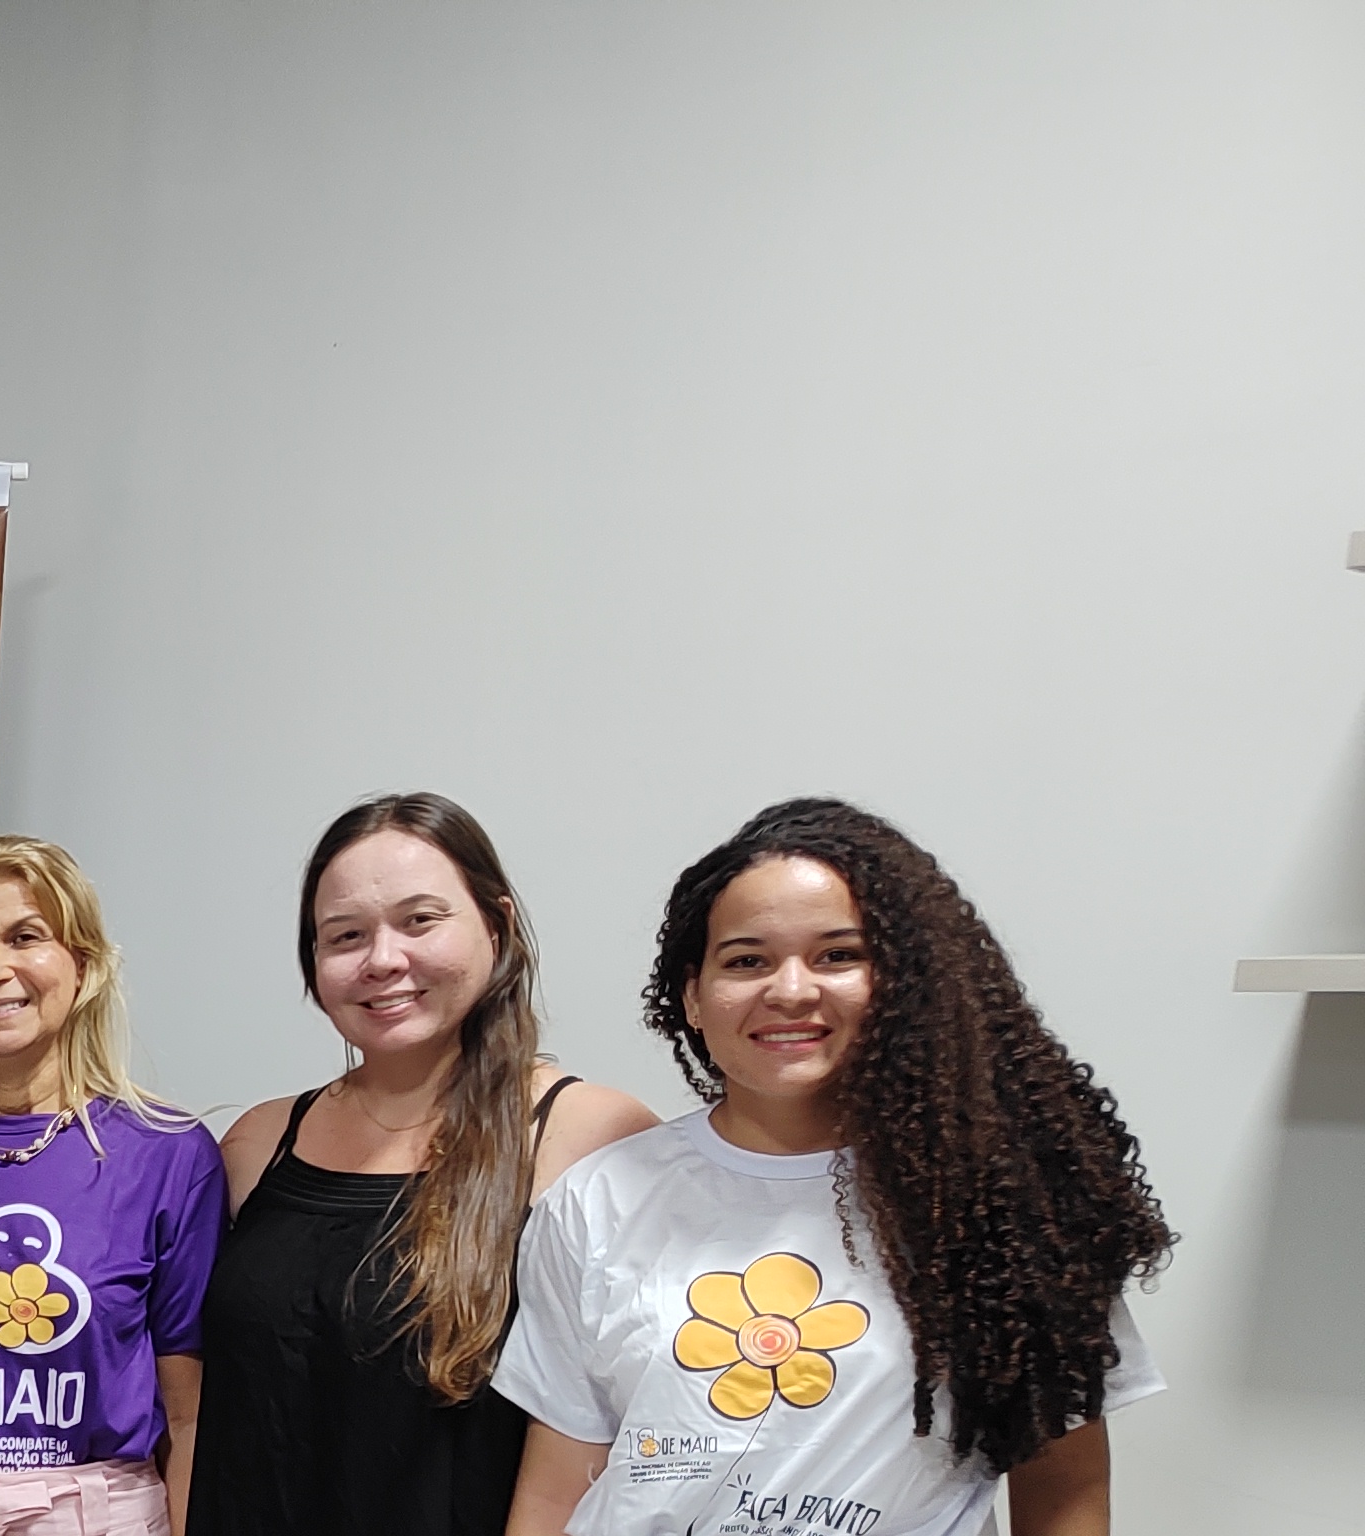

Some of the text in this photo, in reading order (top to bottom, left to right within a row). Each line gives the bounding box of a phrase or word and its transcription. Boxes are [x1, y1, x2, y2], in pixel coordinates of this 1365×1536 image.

[624, 1427, 718, 1460] 18 DE MAIO
